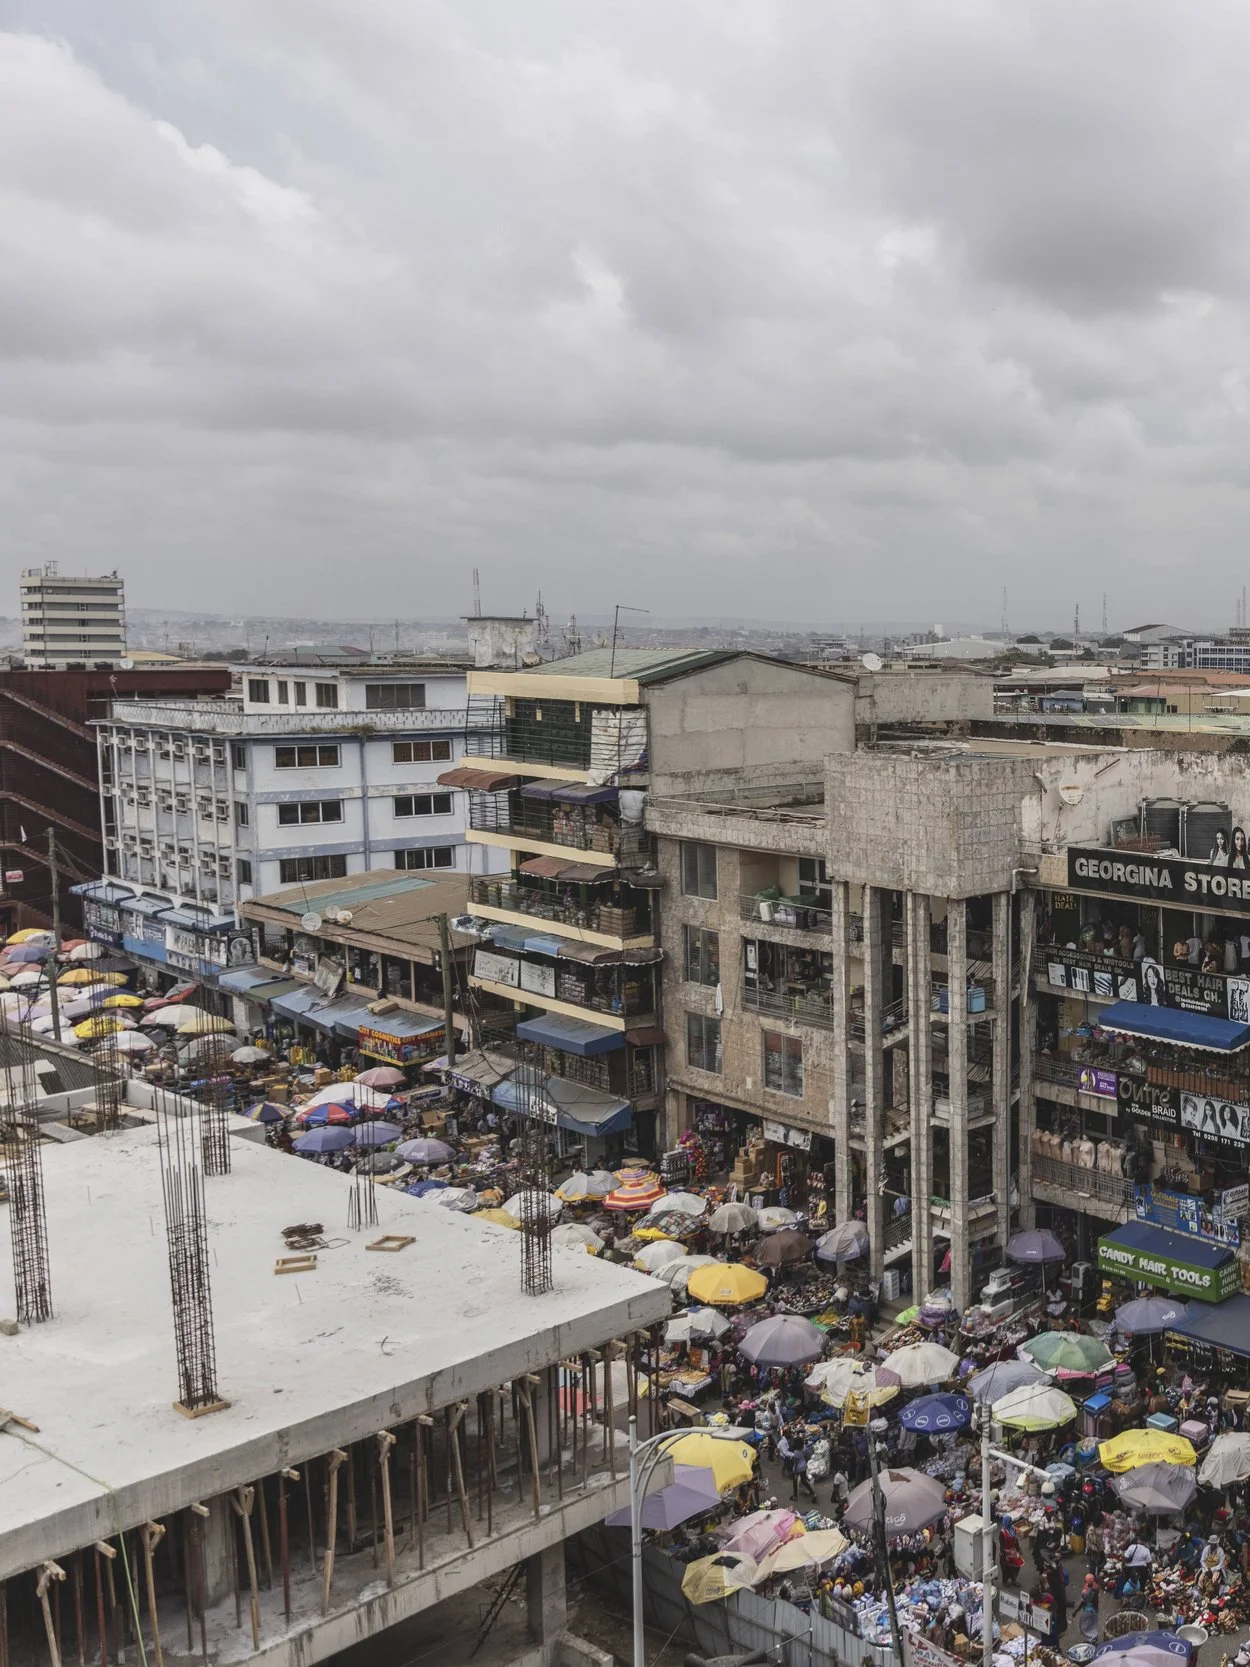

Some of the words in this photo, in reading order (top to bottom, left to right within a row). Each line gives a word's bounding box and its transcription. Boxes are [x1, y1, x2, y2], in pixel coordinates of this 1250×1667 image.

[1075, 858, 1172, 888] GEORGINA
[1055, 902, 1077, 910] DEALS
[1059, 950, 1096, 963] ACCESSORIES
[1165, 969, 1192, 985] BEST
[1197, 975, 1223, 991] HAIR
[1168, 983, 1200, 999] DEALS
[1203, 990, 1222, 1003] GH.
[358, 1026, 370, 1035] CITY
[371, 1030, 401, 1045] COSMETICS
[1152, 1104, 1177, 1118] BRAID
[1099, 1246, 1136, 1266] CANDY
[1139, 1257, 1168, 1276] HAIR
[1170, 1266, 1211, 1288] TOOLS
[1219, 1262, 1240, 1278] CANDY
[1220, 1280, 1241, 1295] TOOLS
[1222, 1274, 1237, 1286] HAIR
[886, 1513, 906, 1527] tigo
